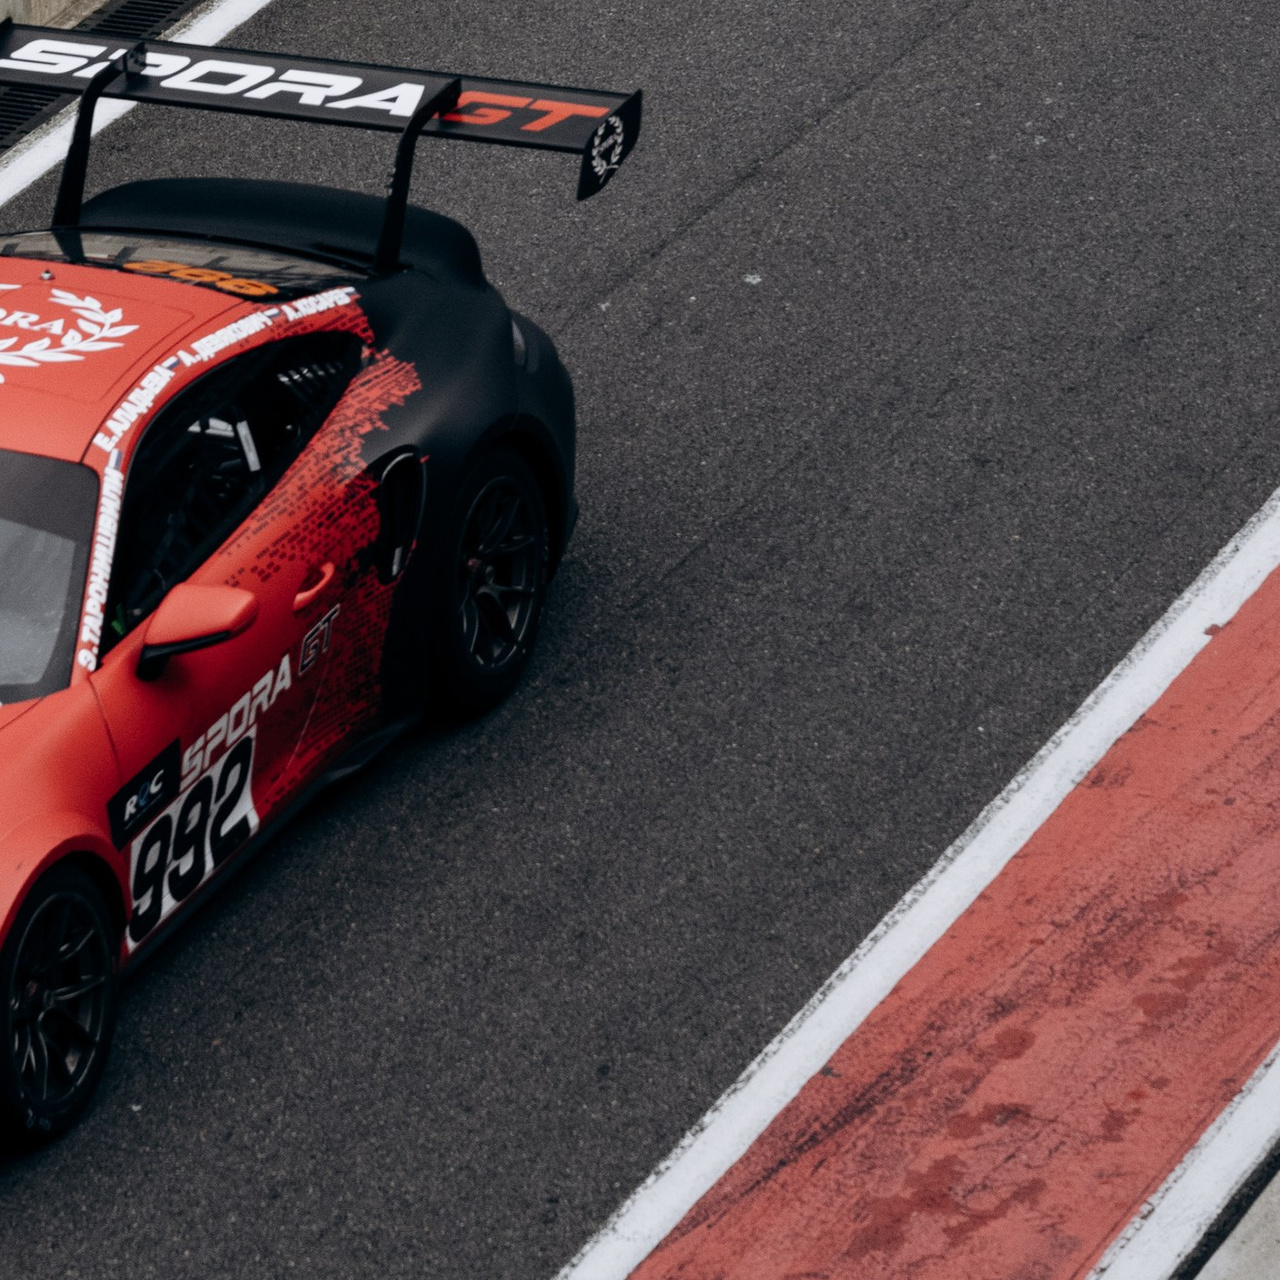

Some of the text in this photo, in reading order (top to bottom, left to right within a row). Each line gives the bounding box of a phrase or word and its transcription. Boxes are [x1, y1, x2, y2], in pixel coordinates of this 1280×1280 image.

[432, 91, 610, 131] GT
[179, 603, 341, 794] SPORA GT
[128, 734, 255, 944] 992
